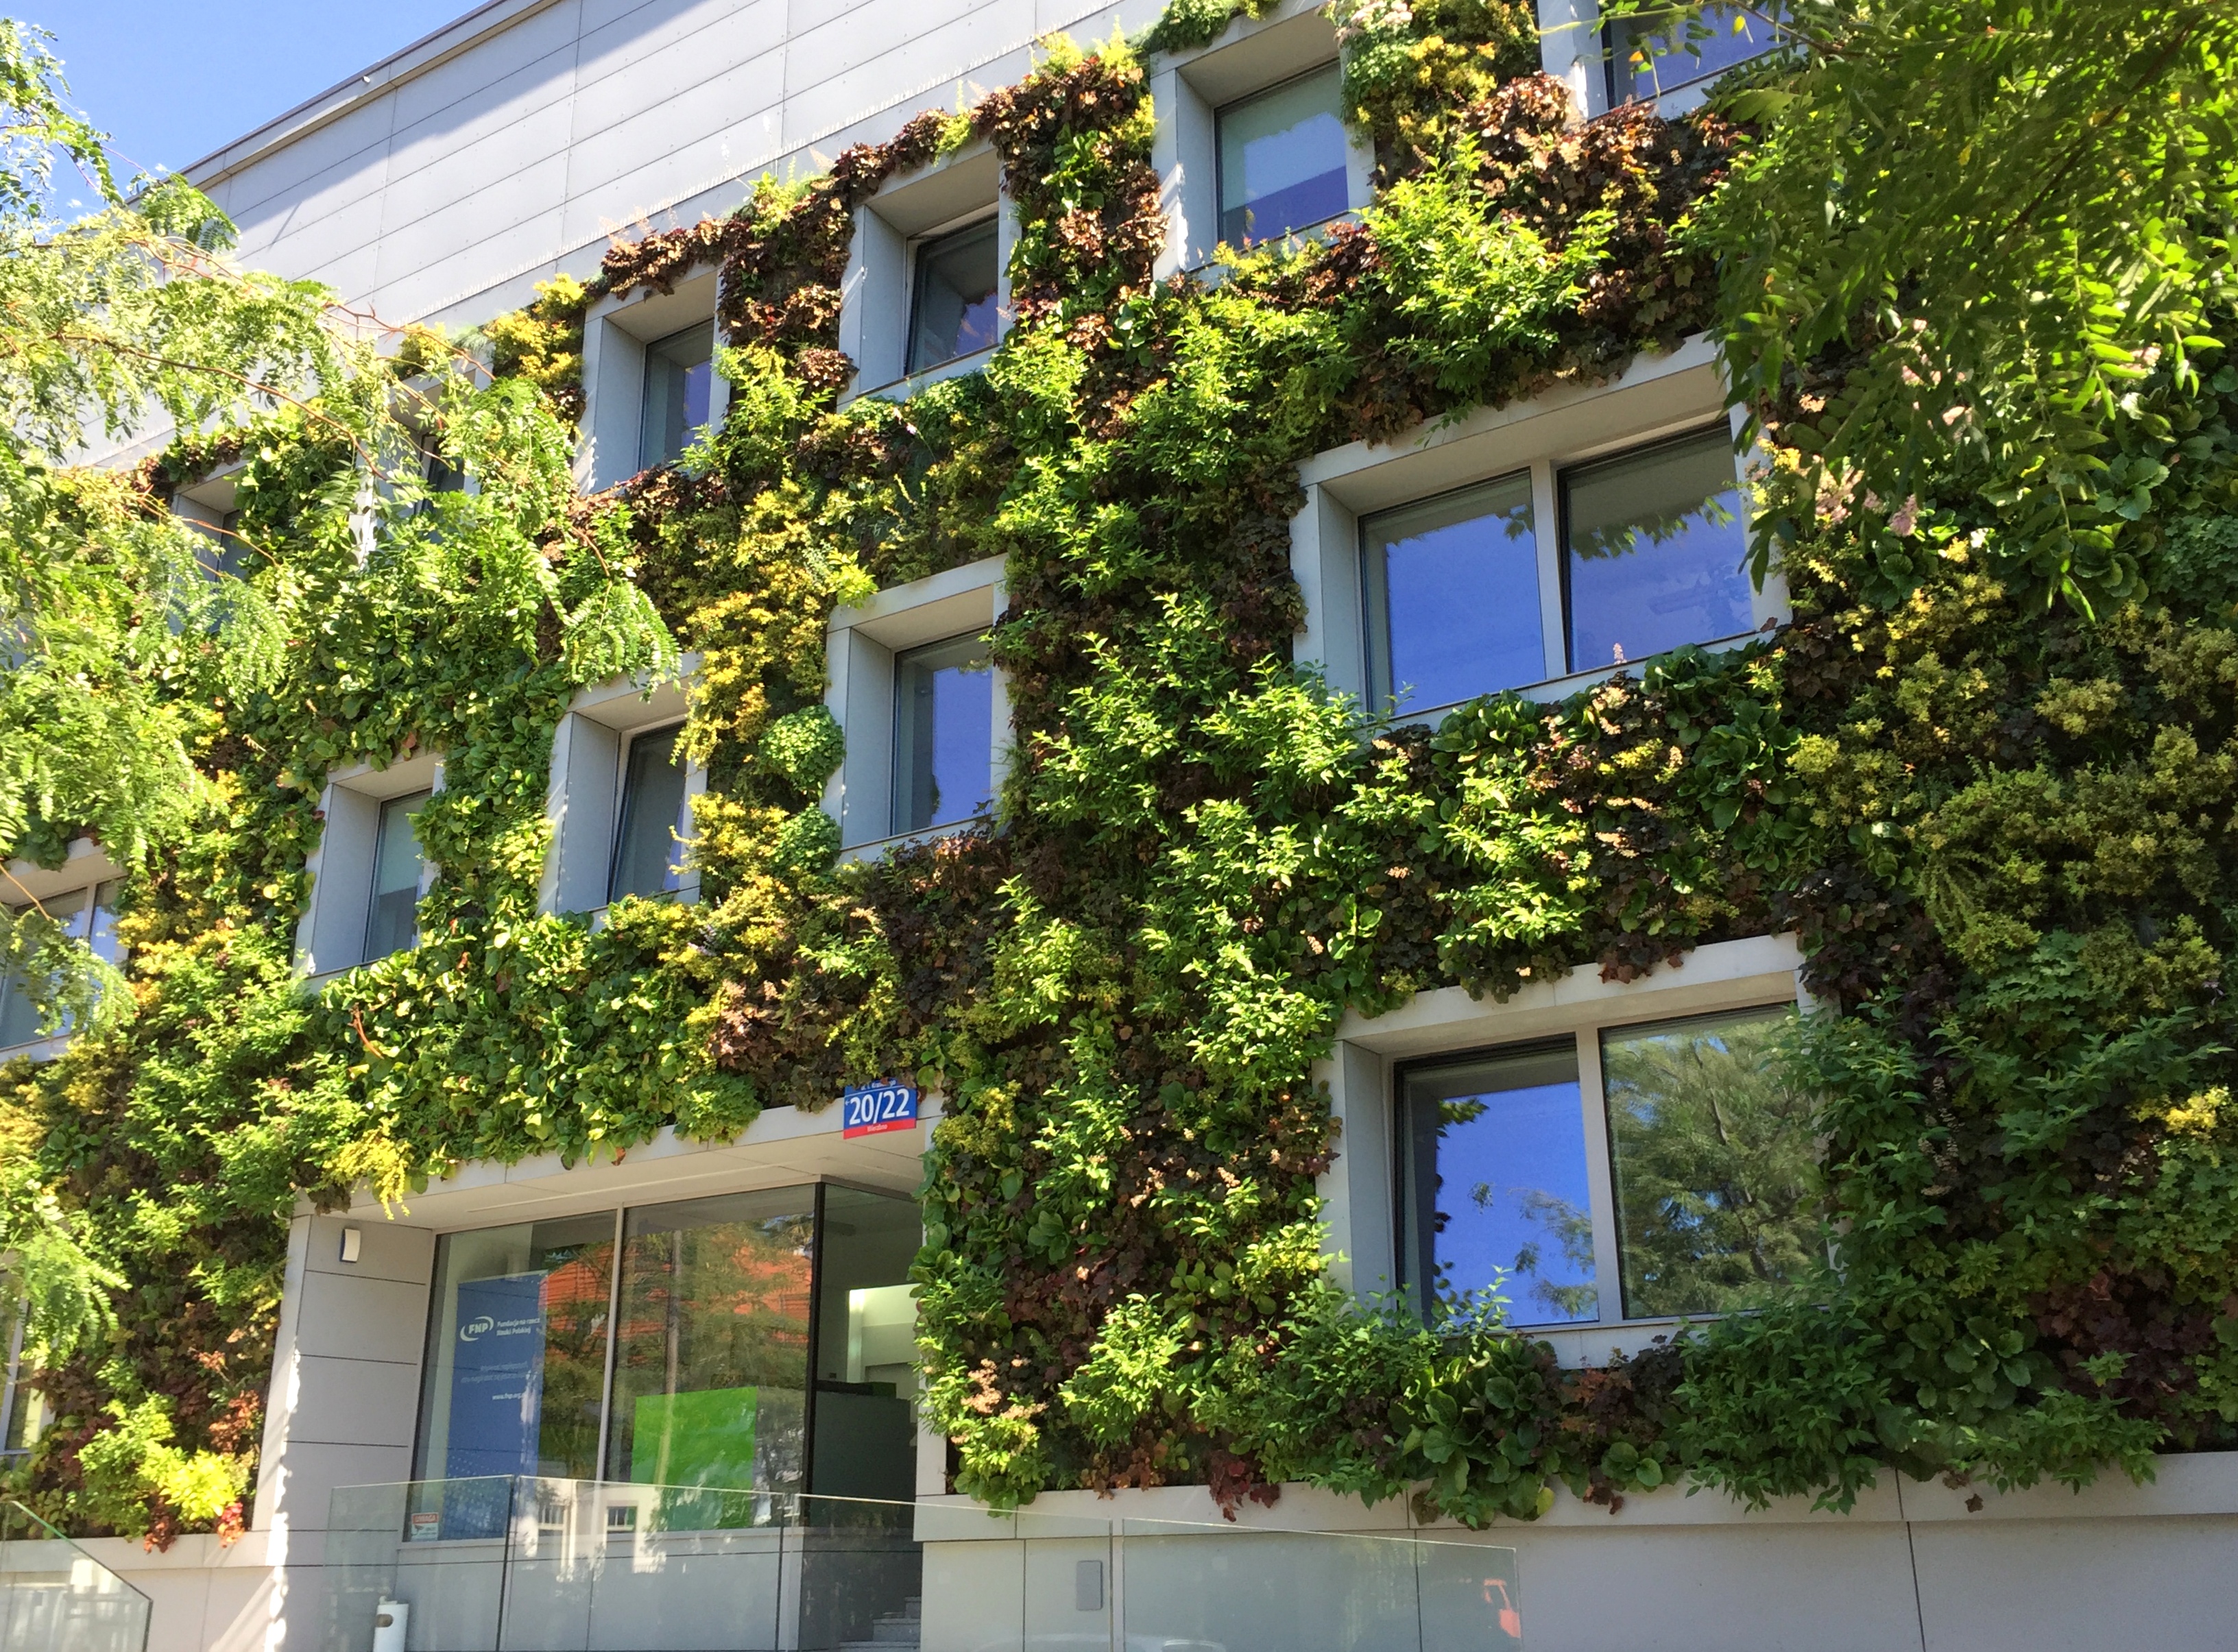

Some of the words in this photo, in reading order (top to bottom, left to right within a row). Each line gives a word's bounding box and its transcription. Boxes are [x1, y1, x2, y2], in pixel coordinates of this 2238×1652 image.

[849, 1088, 910, 1126] 20/22
[497, 1319, 519, 1327] Fundacja
[468, 1323, 488, 1334] FNP
[496, 1328, 512, 1336] Nauki
[512, 1326, 531, 1335] Polskiej
